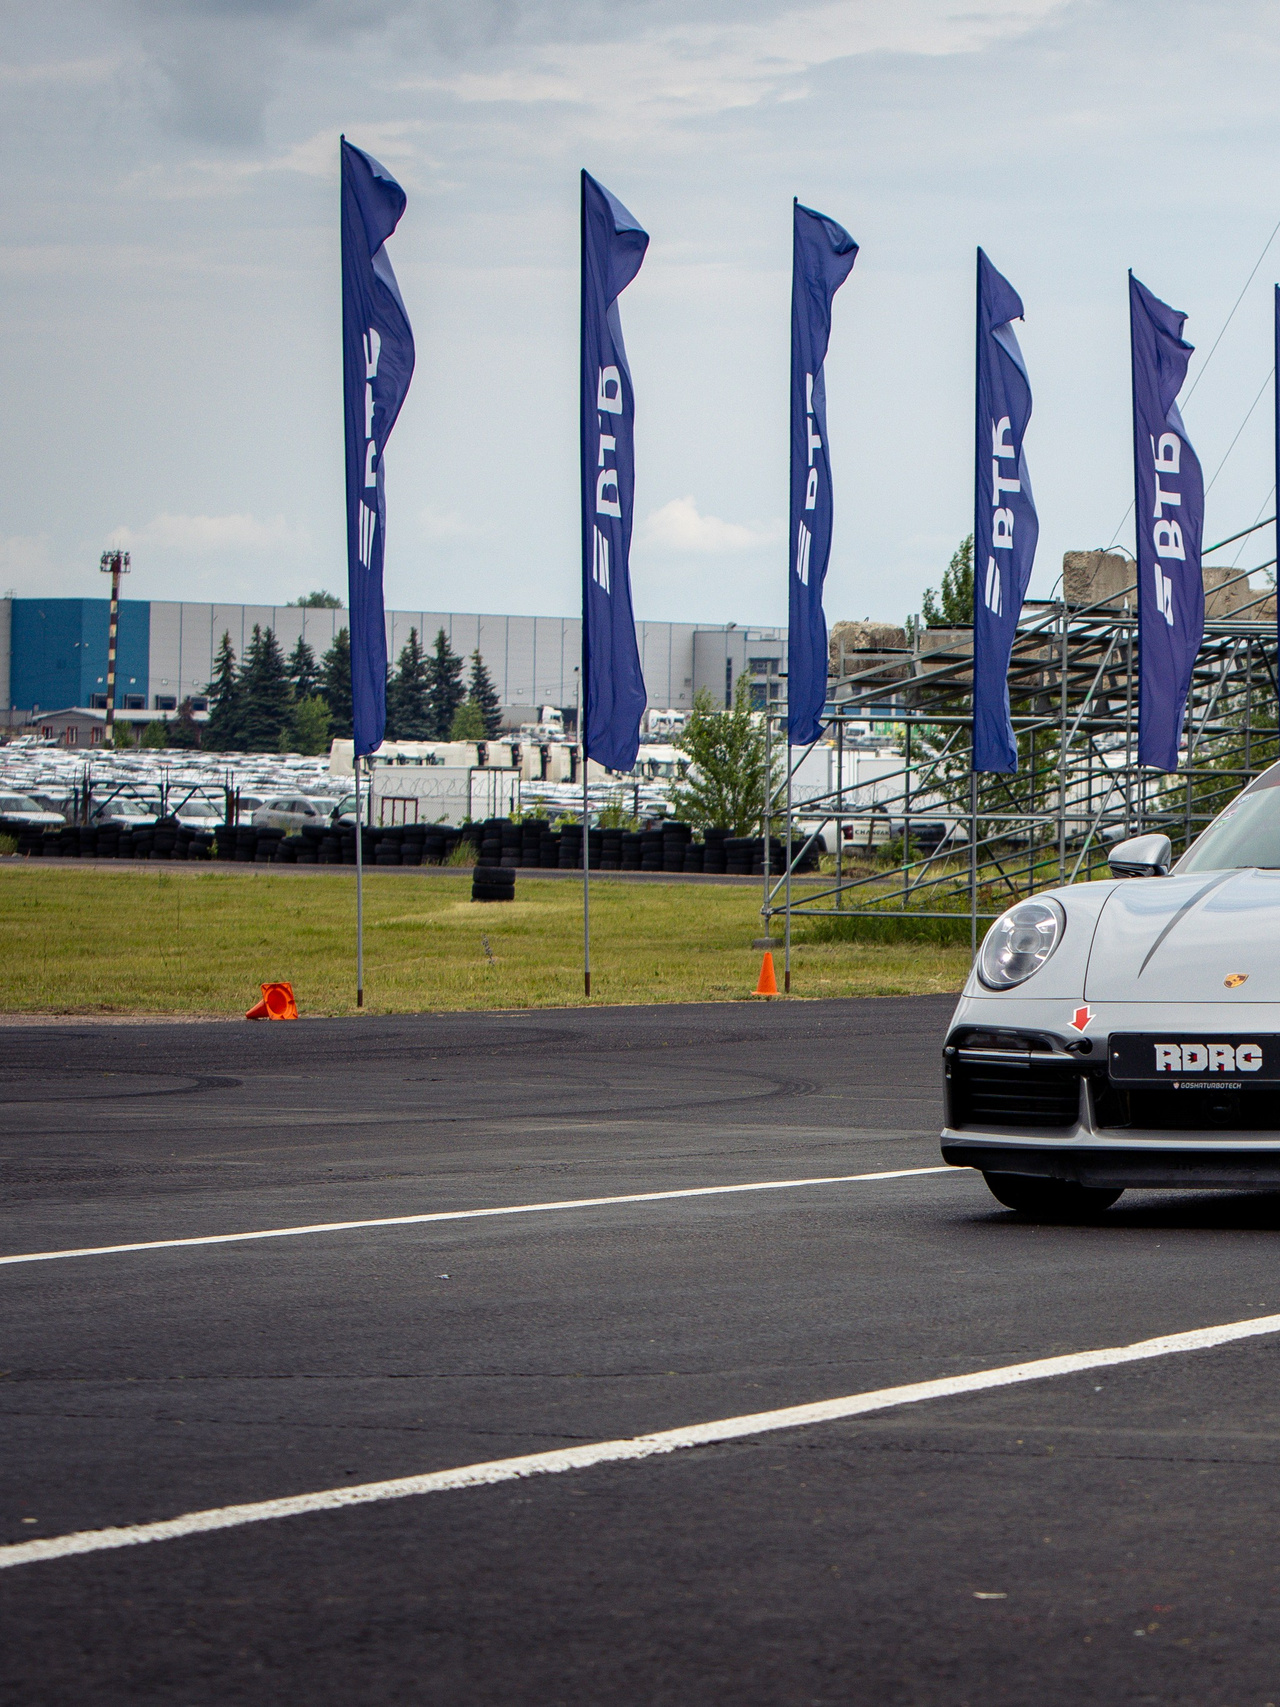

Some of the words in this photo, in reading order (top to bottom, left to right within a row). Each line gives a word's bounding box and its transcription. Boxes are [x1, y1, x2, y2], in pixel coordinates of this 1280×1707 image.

[596, 365, 623, 518] ВТБ
[1150, 432, 1186, 560] ВТБ
[1154, 1043, 1263, 1071] RDRC
